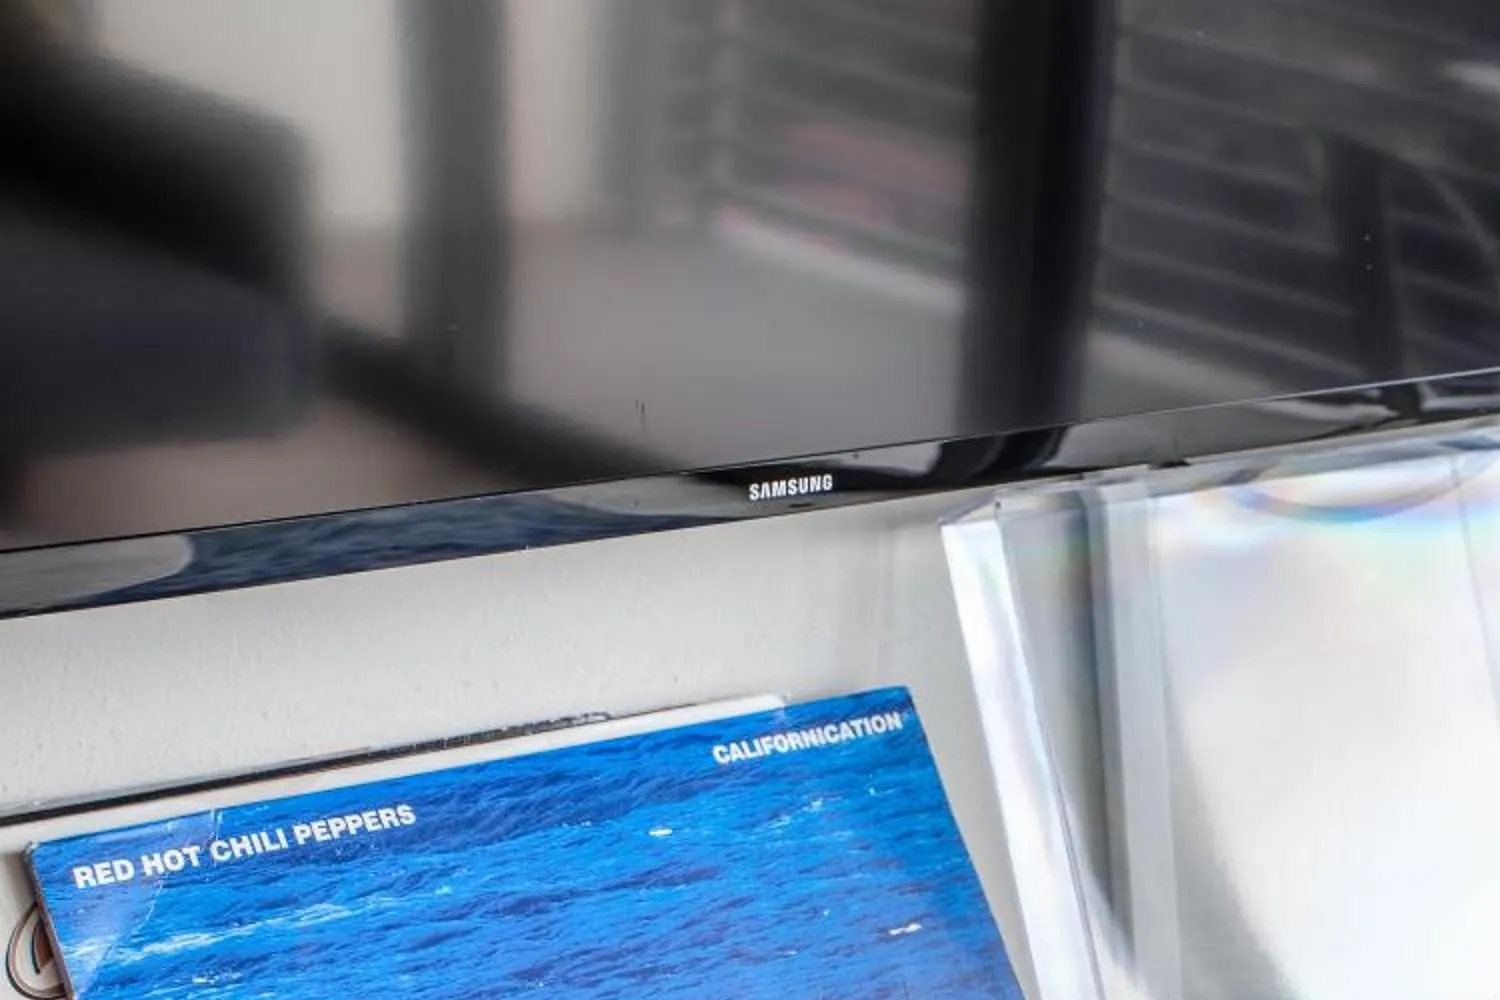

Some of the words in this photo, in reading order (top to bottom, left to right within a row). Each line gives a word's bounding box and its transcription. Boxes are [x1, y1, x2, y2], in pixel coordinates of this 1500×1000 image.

[748, 474, 833, 501] SAMSUNG
[712, 711, 904, 764] CALIFORNICATION
[73, 859, 135, 889] RED
[140, 846, 202, 877] HOT
[210, 829, 289, 862] CHILI
[294, 804, 417, 846] PEPPERS
